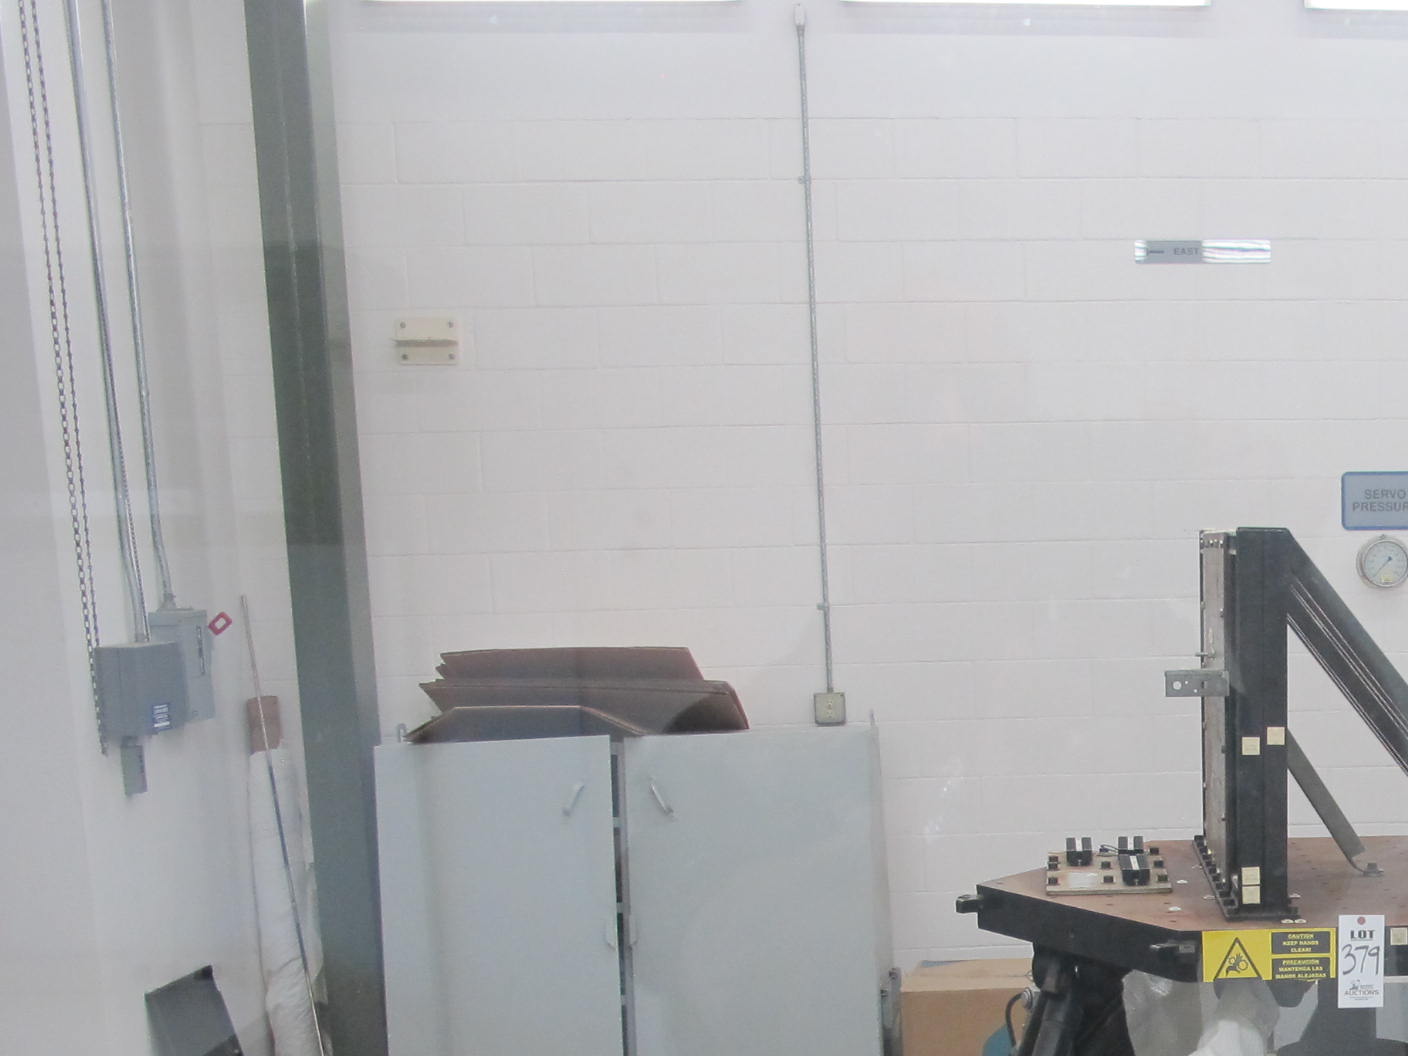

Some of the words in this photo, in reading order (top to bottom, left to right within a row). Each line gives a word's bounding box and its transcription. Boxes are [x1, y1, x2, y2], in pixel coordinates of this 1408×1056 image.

[1173, 247, 1199, 256] EAST
[1363, 488, 1407, 499] SERVO
[1350, 929, 1375, 939] LOT
[1341, 943, 1381, 976] 379
